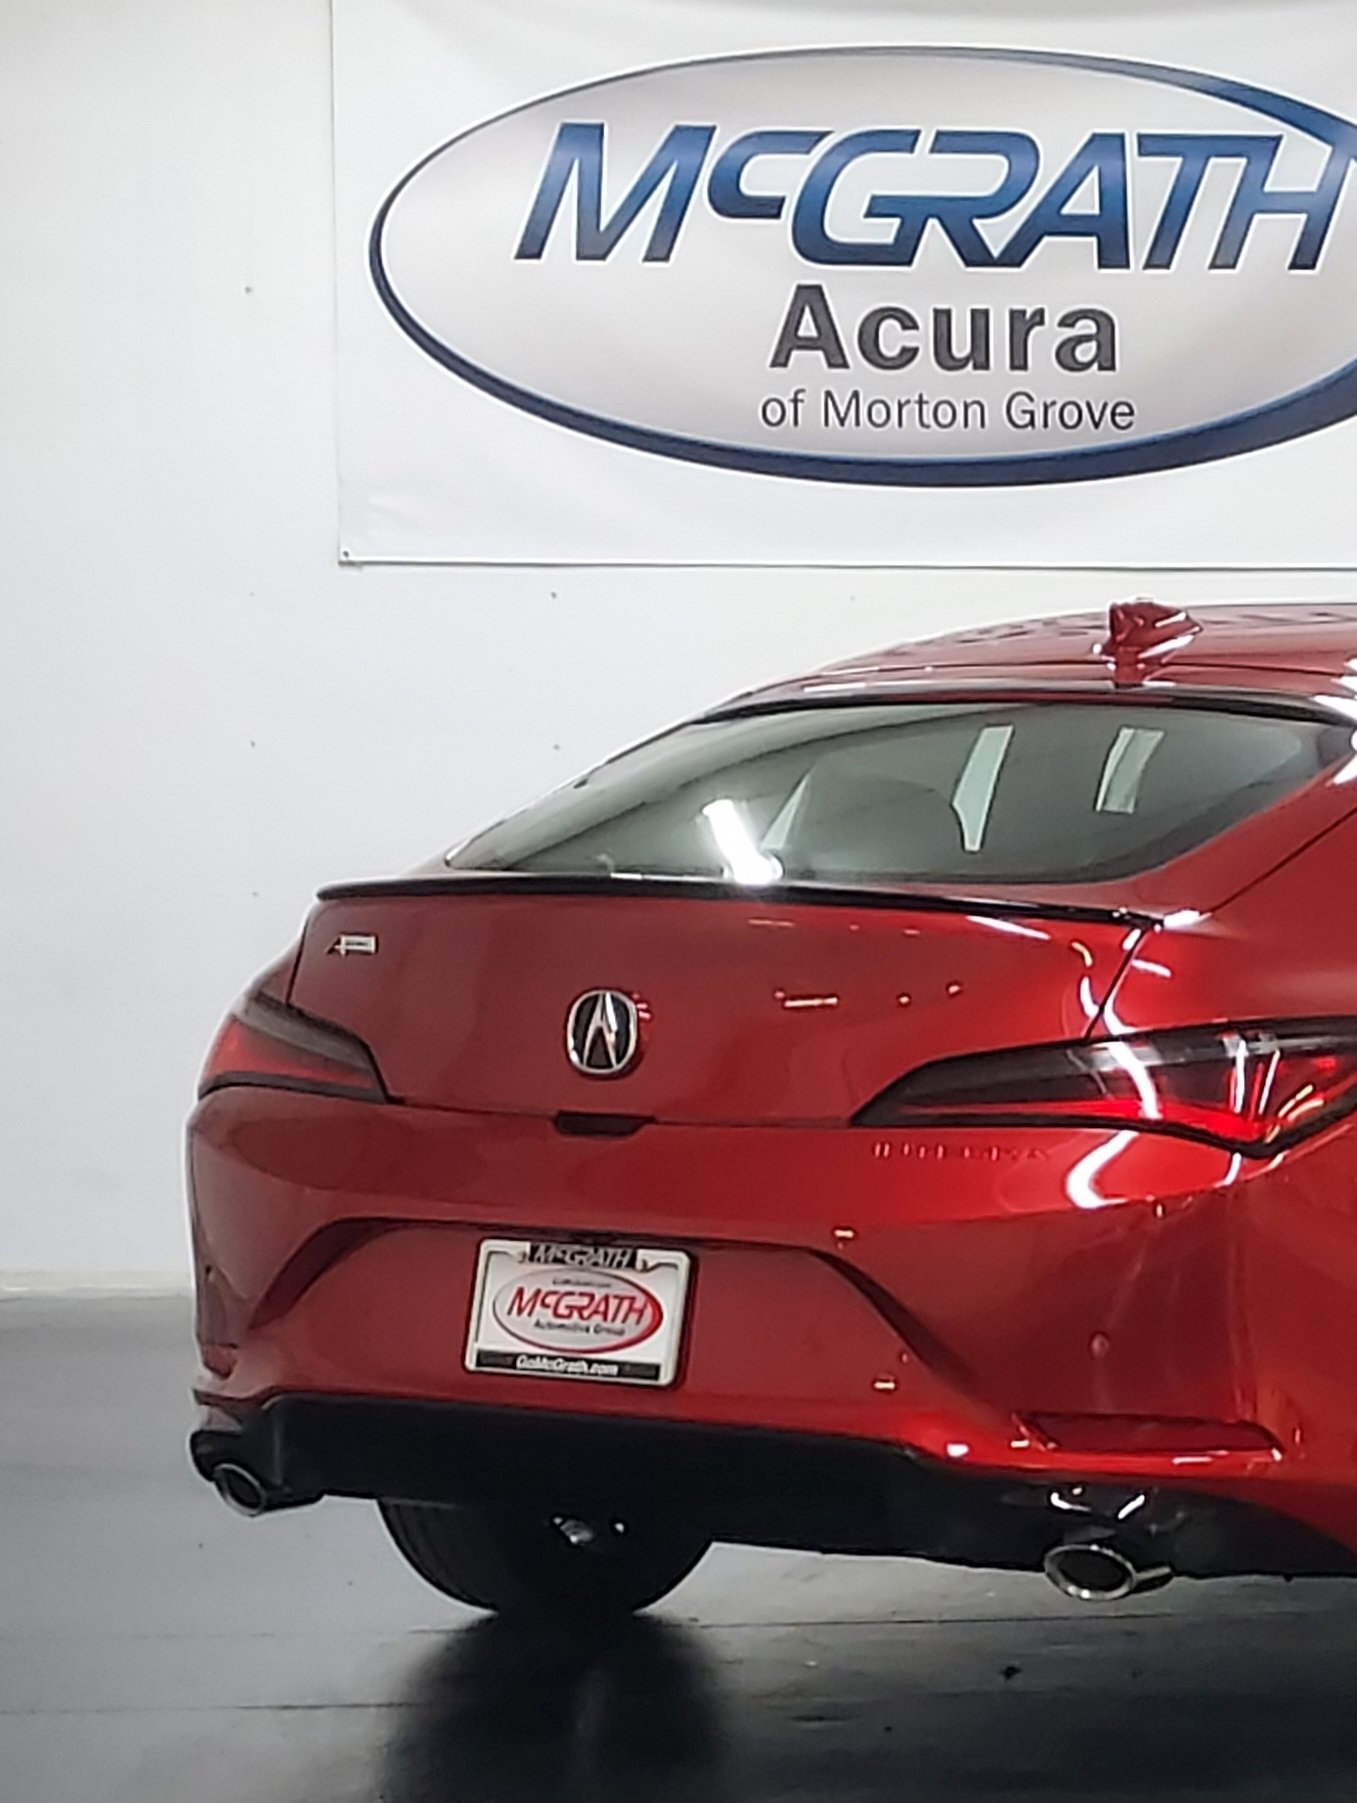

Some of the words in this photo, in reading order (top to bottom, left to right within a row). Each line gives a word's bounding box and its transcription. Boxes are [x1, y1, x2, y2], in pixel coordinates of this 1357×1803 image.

[769, 284, 1117, 372] Acura
[759, 389, 806, 430] of
[822, 390, 988, 429] Morton
[1004, 391, 1136, 431] Grove
